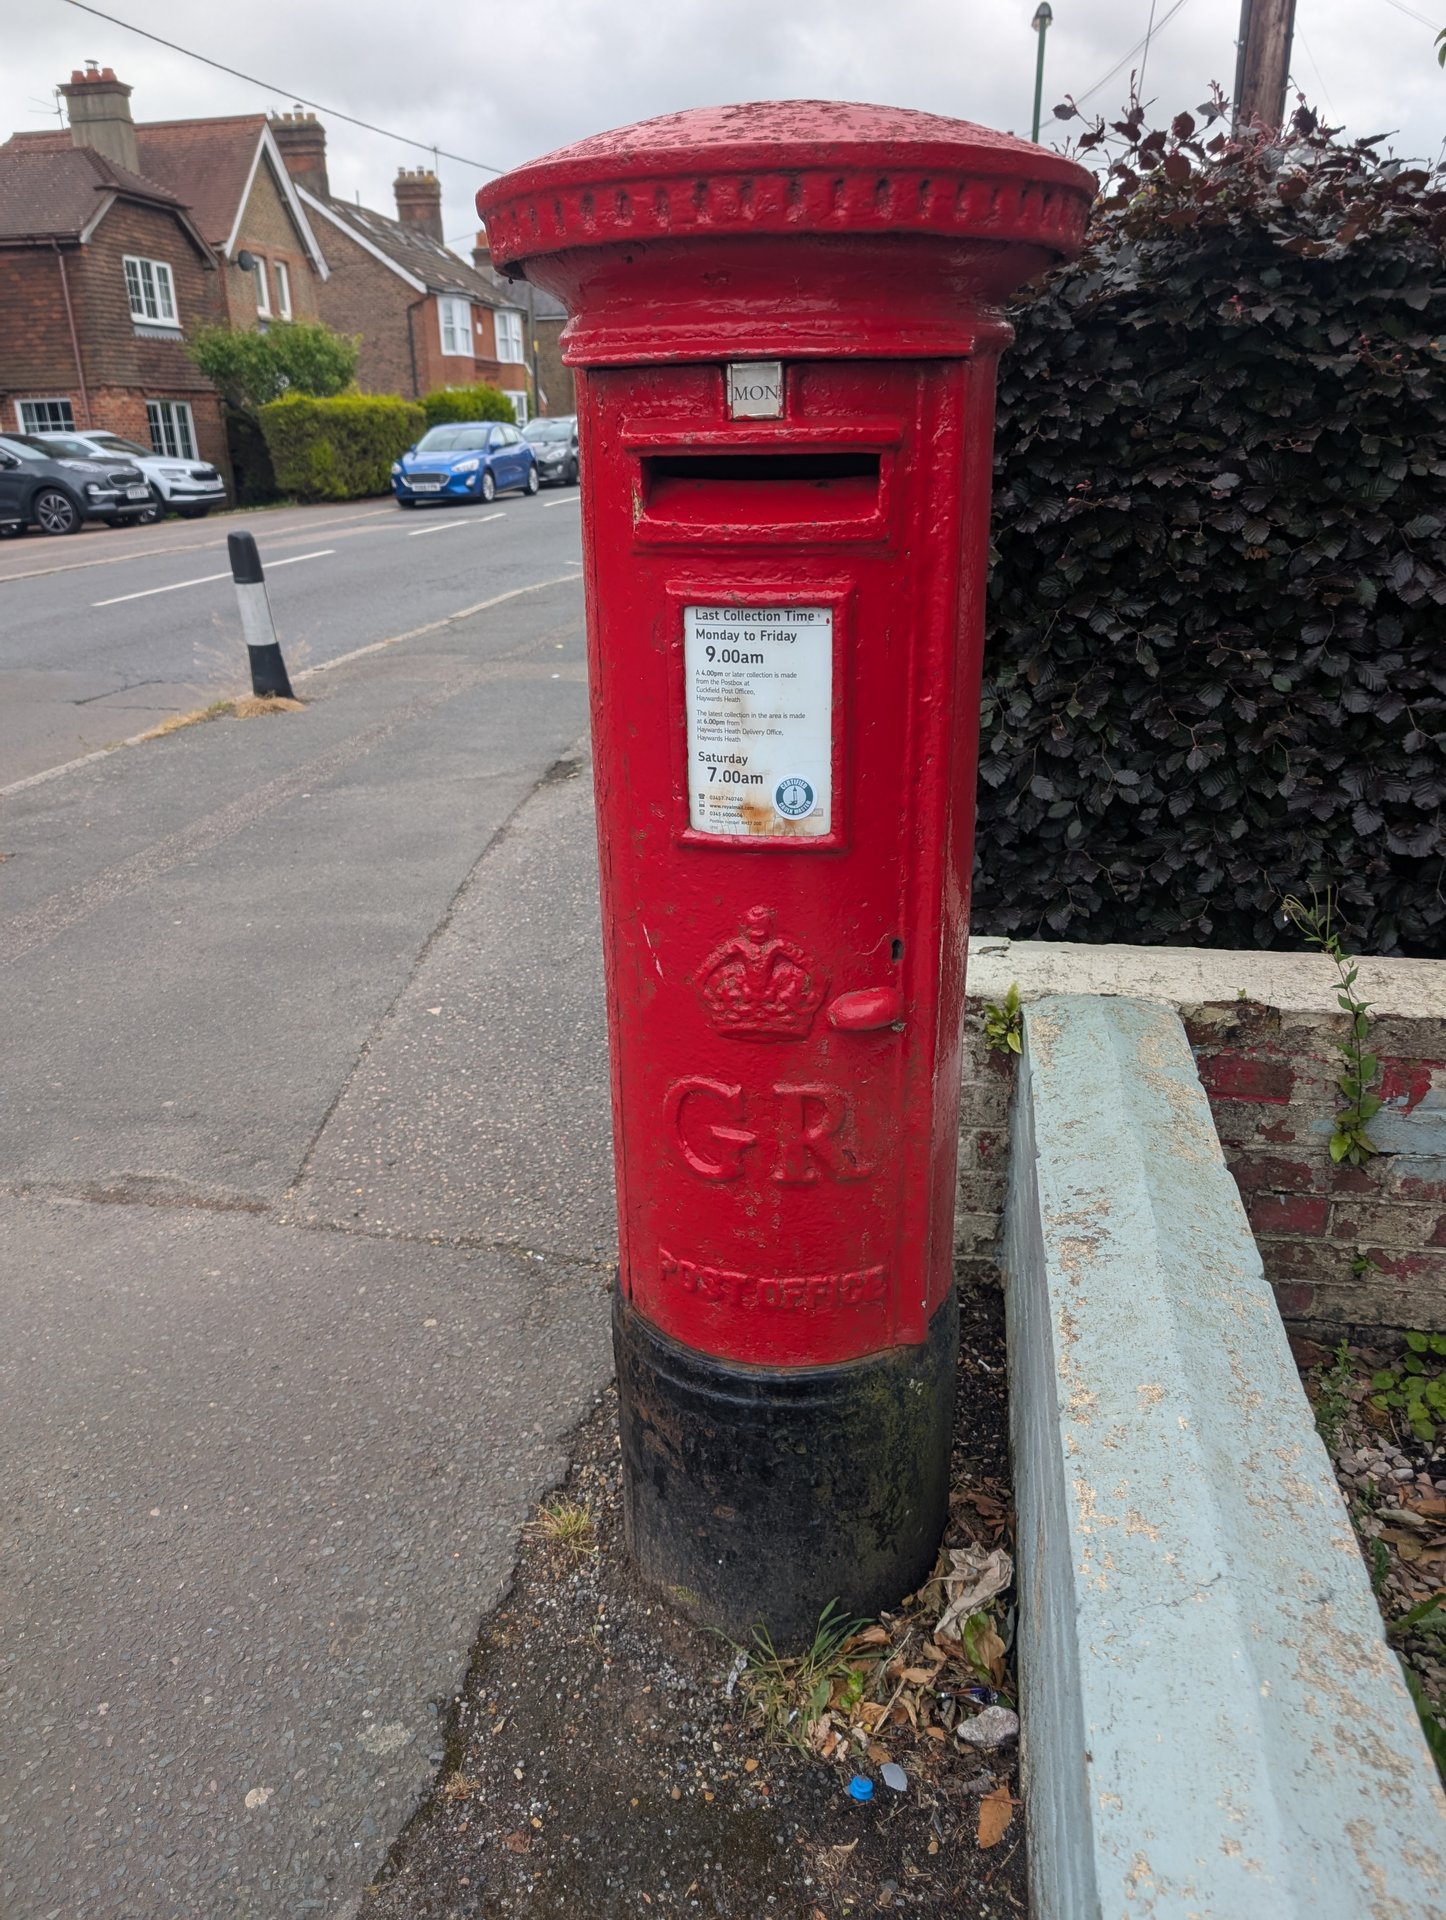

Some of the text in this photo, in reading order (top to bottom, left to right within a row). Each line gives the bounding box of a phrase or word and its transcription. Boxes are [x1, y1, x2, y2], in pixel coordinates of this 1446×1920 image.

[733, 385, 778, 400] MON
[695, 609, 720, 621] Last
[723, 609, 781, 622] Collection
[695, 628, 797, 644] Monday to Friday
[705, 645, 764, 664] 9.00am
[701, 669, 724, 678] 4.00pm
[720, 678, 742, 686] Postbox
[696, 686, 720, 694] Cuckfield
[703, 718, 725, 726] 6.00pm
[697, 726, 723, 734] Haywards
[724, 727, 741, 735] Heath
[742, 728, 765, 736] Delivery
[697, 734, 723, 742] Haywards
[698, 751, 748, 767] Saturday
[707, 766, 764, 784] 7.00am
[662, 1075, 878, 1184] GR
[659, 1248, 884, 1309] POST OFFICE
